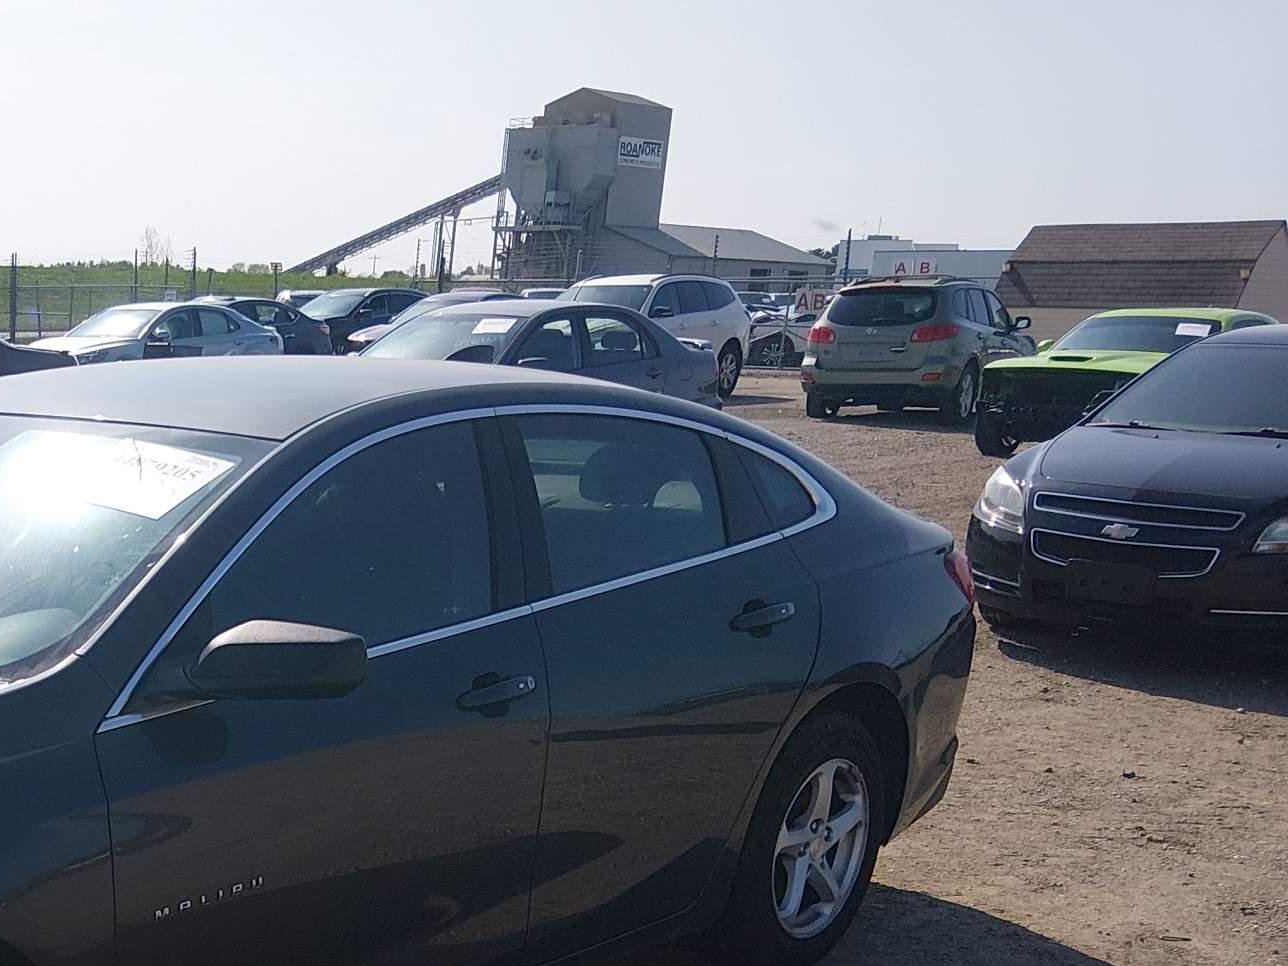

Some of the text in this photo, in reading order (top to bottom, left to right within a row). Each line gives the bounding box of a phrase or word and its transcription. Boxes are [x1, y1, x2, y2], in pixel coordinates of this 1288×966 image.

[620, 141, 662, 157] ROANOKE
[896, 262, 930, 274] A B
[795, 292, 826, 311] A B
[154, 876, 264, 919] MALIBU
